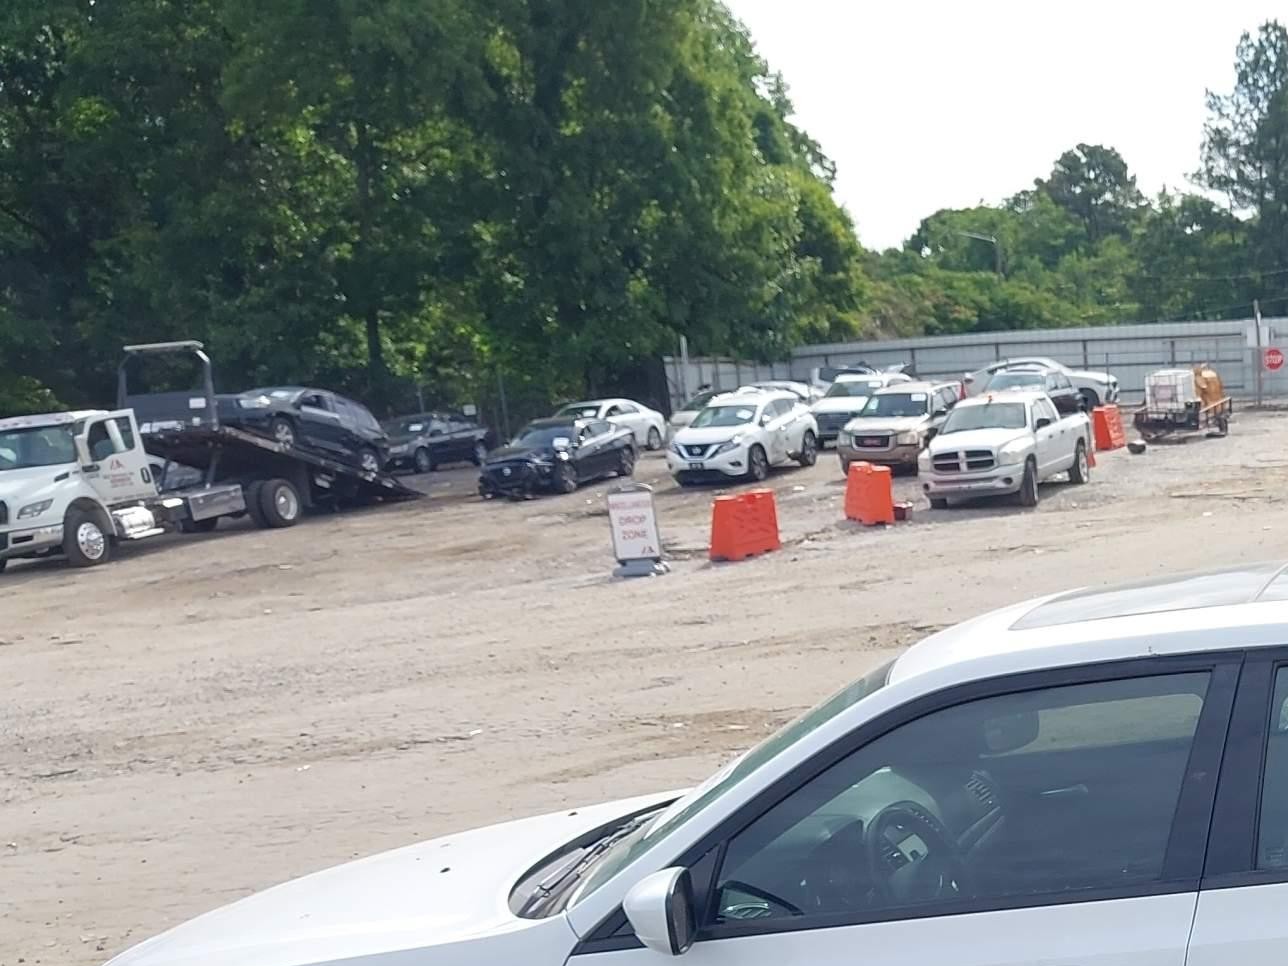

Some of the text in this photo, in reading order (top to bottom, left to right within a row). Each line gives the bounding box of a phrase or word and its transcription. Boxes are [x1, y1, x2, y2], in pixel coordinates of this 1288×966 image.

[1264, 354, 1284, 365] STOP
[618, 514, 647, 527] DROP
[621, 528, 649, 541] ZONE
